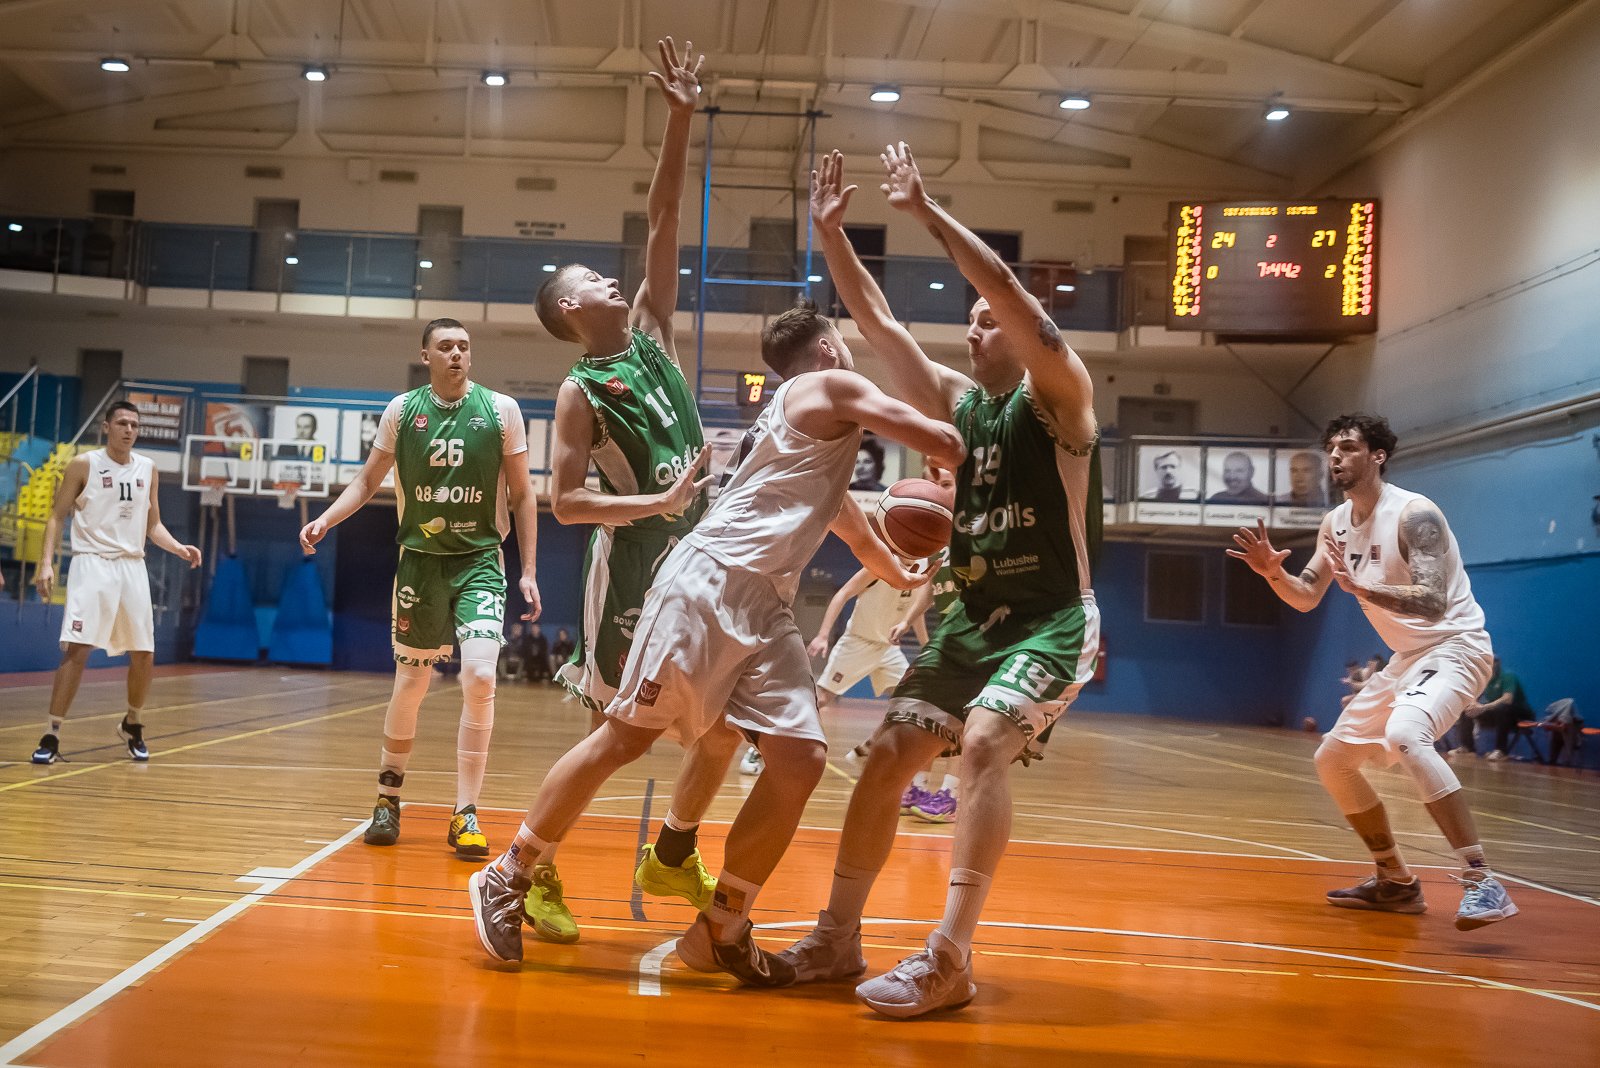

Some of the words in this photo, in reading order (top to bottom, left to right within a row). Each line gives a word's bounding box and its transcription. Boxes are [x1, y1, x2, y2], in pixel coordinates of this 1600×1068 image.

[1211, 231, 1236, 249] 24
[1265, 234, 1278, 248] 2
[1311, 230, 1337, 248] 27
[1206, 265, 1219, 279] 0
[1324, 265, 1337, 279] 2
[749, 385, 762, 402] 8
[429, 438, 465, 467] 26
[655, 456, 684, 485] Q8
[971, 443, 1002, 487] 19
[119, 482, 132, 501] 11
[415, 485, 431, 503] Q8
[450, 486, 482, 503] Oils
[990, 502, 1036, 532] Oils
[992, 554, 1039, 569] Lubuskie
[1349, 553, 1363, 571] 7
[476, 590, 505, 622] 26
[1000, 653, 1055, 698] 19
[1421, 669, 1438, 687] 7
